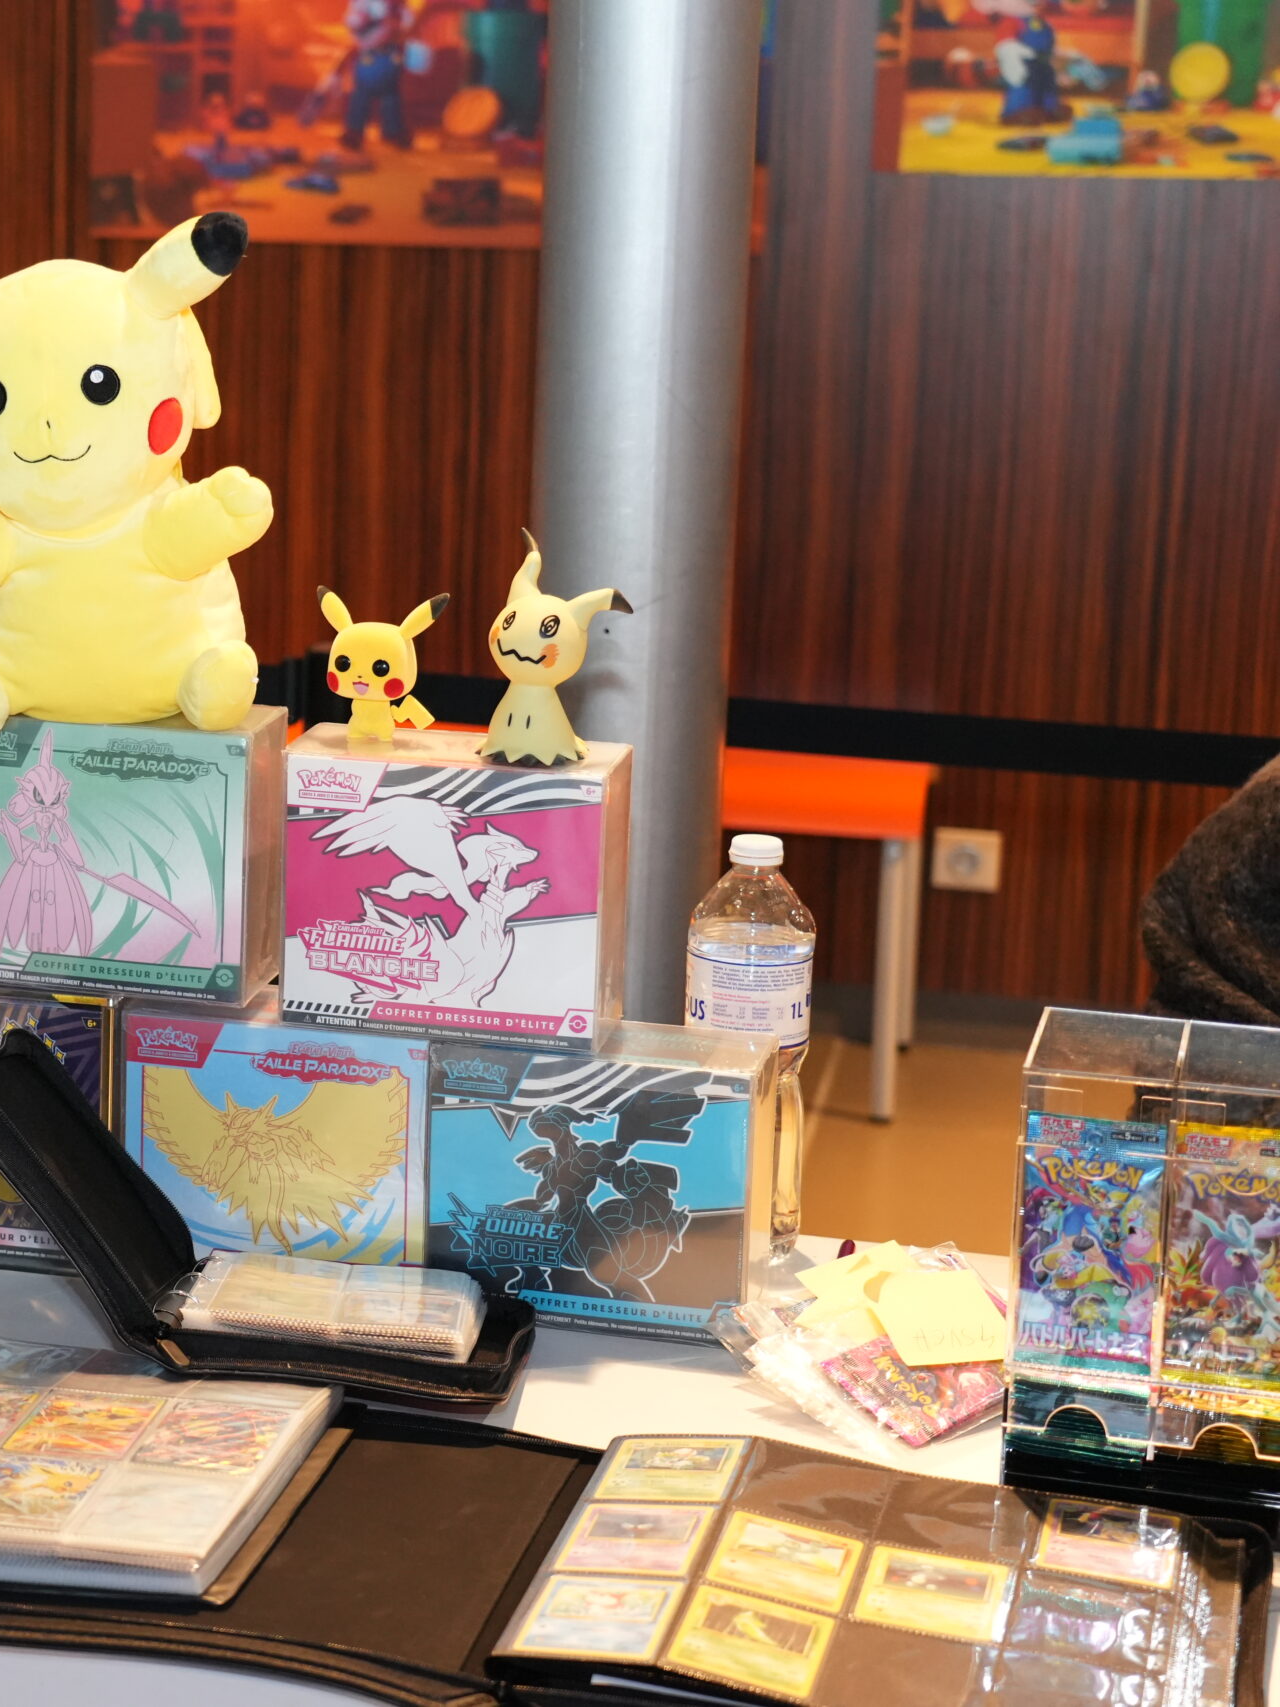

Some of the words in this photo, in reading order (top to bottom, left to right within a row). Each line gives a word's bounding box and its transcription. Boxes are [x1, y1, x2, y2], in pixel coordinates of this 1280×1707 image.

[72, 753, 121, 769] FAILLE
[122, 757, 210, 776] PARADOXE
[309, 929, 406, 953] FLAMME
[34, 960, 84, 972] COFFRET
[90, 965, 151, 979] DRESSEUR
[307, 950, 439, 982] BLANCHE
[87, 1019, 97, 1028] 6+
[316, 1015, 357, 1027] ATTENTION
[363, 1022, 383, 1030] DANGER
[376, 1006, 431, 1019] COFFRET
[436, 1012, 500, 1026] DRESSEUR
[506, 1018, 555, 1030] D'ÉLITE
[253, 1055, 303, 1070] FAILLE
[304, 1060, 392, 1078] PARADOXE
[1186, 1135, 1232, 1147] ポケモン
[471, 1215, 564, 1240] FOUDRE
[472, 1235, 561, 1266] NOIRE
[582, 1303, 647, 1316] DRESSEUR
